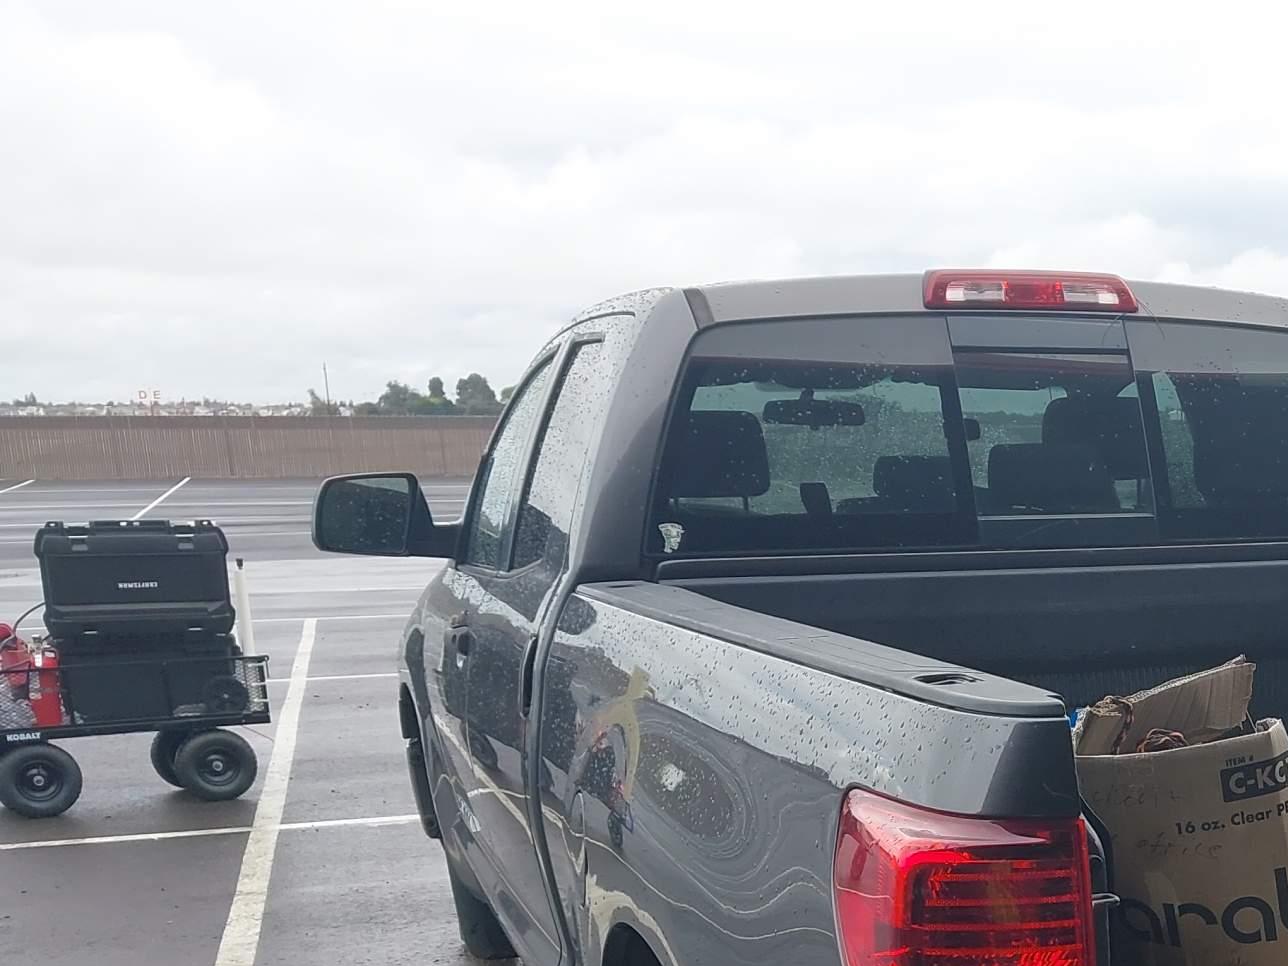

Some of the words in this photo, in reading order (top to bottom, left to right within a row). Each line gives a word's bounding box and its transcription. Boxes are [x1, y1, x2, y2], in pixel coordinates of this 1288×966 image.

[6, 731, 41, 742] KOBALT
[1225, 757, 1246, 767] ITEM
[1176, 821, 1196, 835] 16
[1201, 820, 1226, 832] oz.
[1230, 809, 1273, 826] Clear
